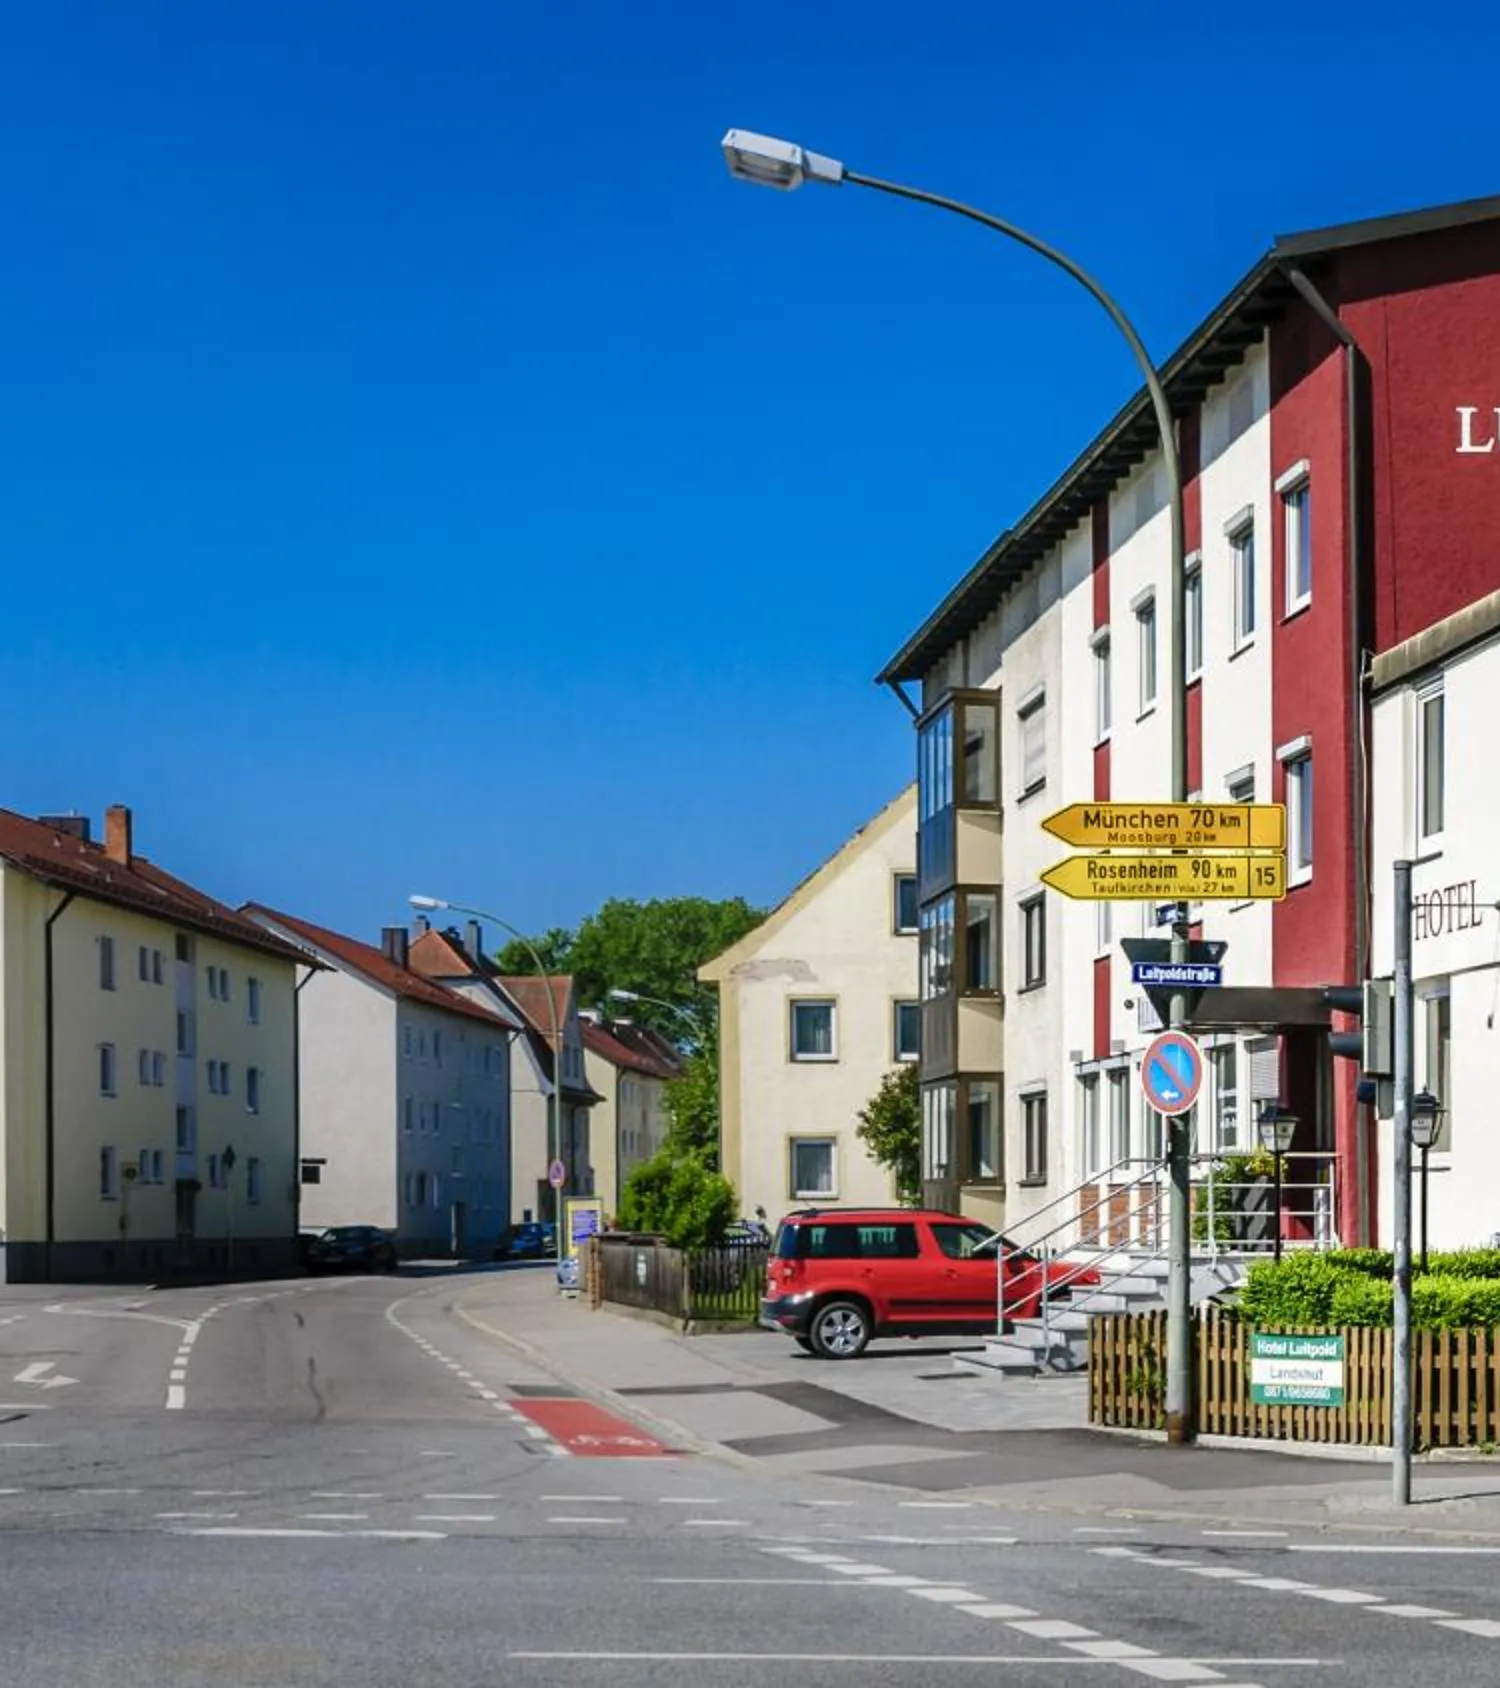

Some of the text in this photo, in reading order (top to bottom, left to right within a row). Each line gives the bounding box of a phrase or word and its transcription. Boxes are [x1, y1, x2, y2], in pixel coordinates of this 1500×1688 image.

[1083, 809, 1241, 829] München 70 km
[1107, 831, 1177, 844] Moosburg
[1185, 831, 1201, 843] 20
[1087, 859, 1237, 879] Rosenheim 90 km
[1255, 867, 1276, 886] 15
[1092, 881, 1171, 893] Taufkirchen
[1203, 882, 1218, 893] 27
[1414, 879, 1483, 941] HOTEL
[1138, 966, 1217, 983] Luitpoldstraße
[1257, 1339, 1337, 1358] Hotel Luitpold
[1270, 1367, 1323, 1380] Landshut
